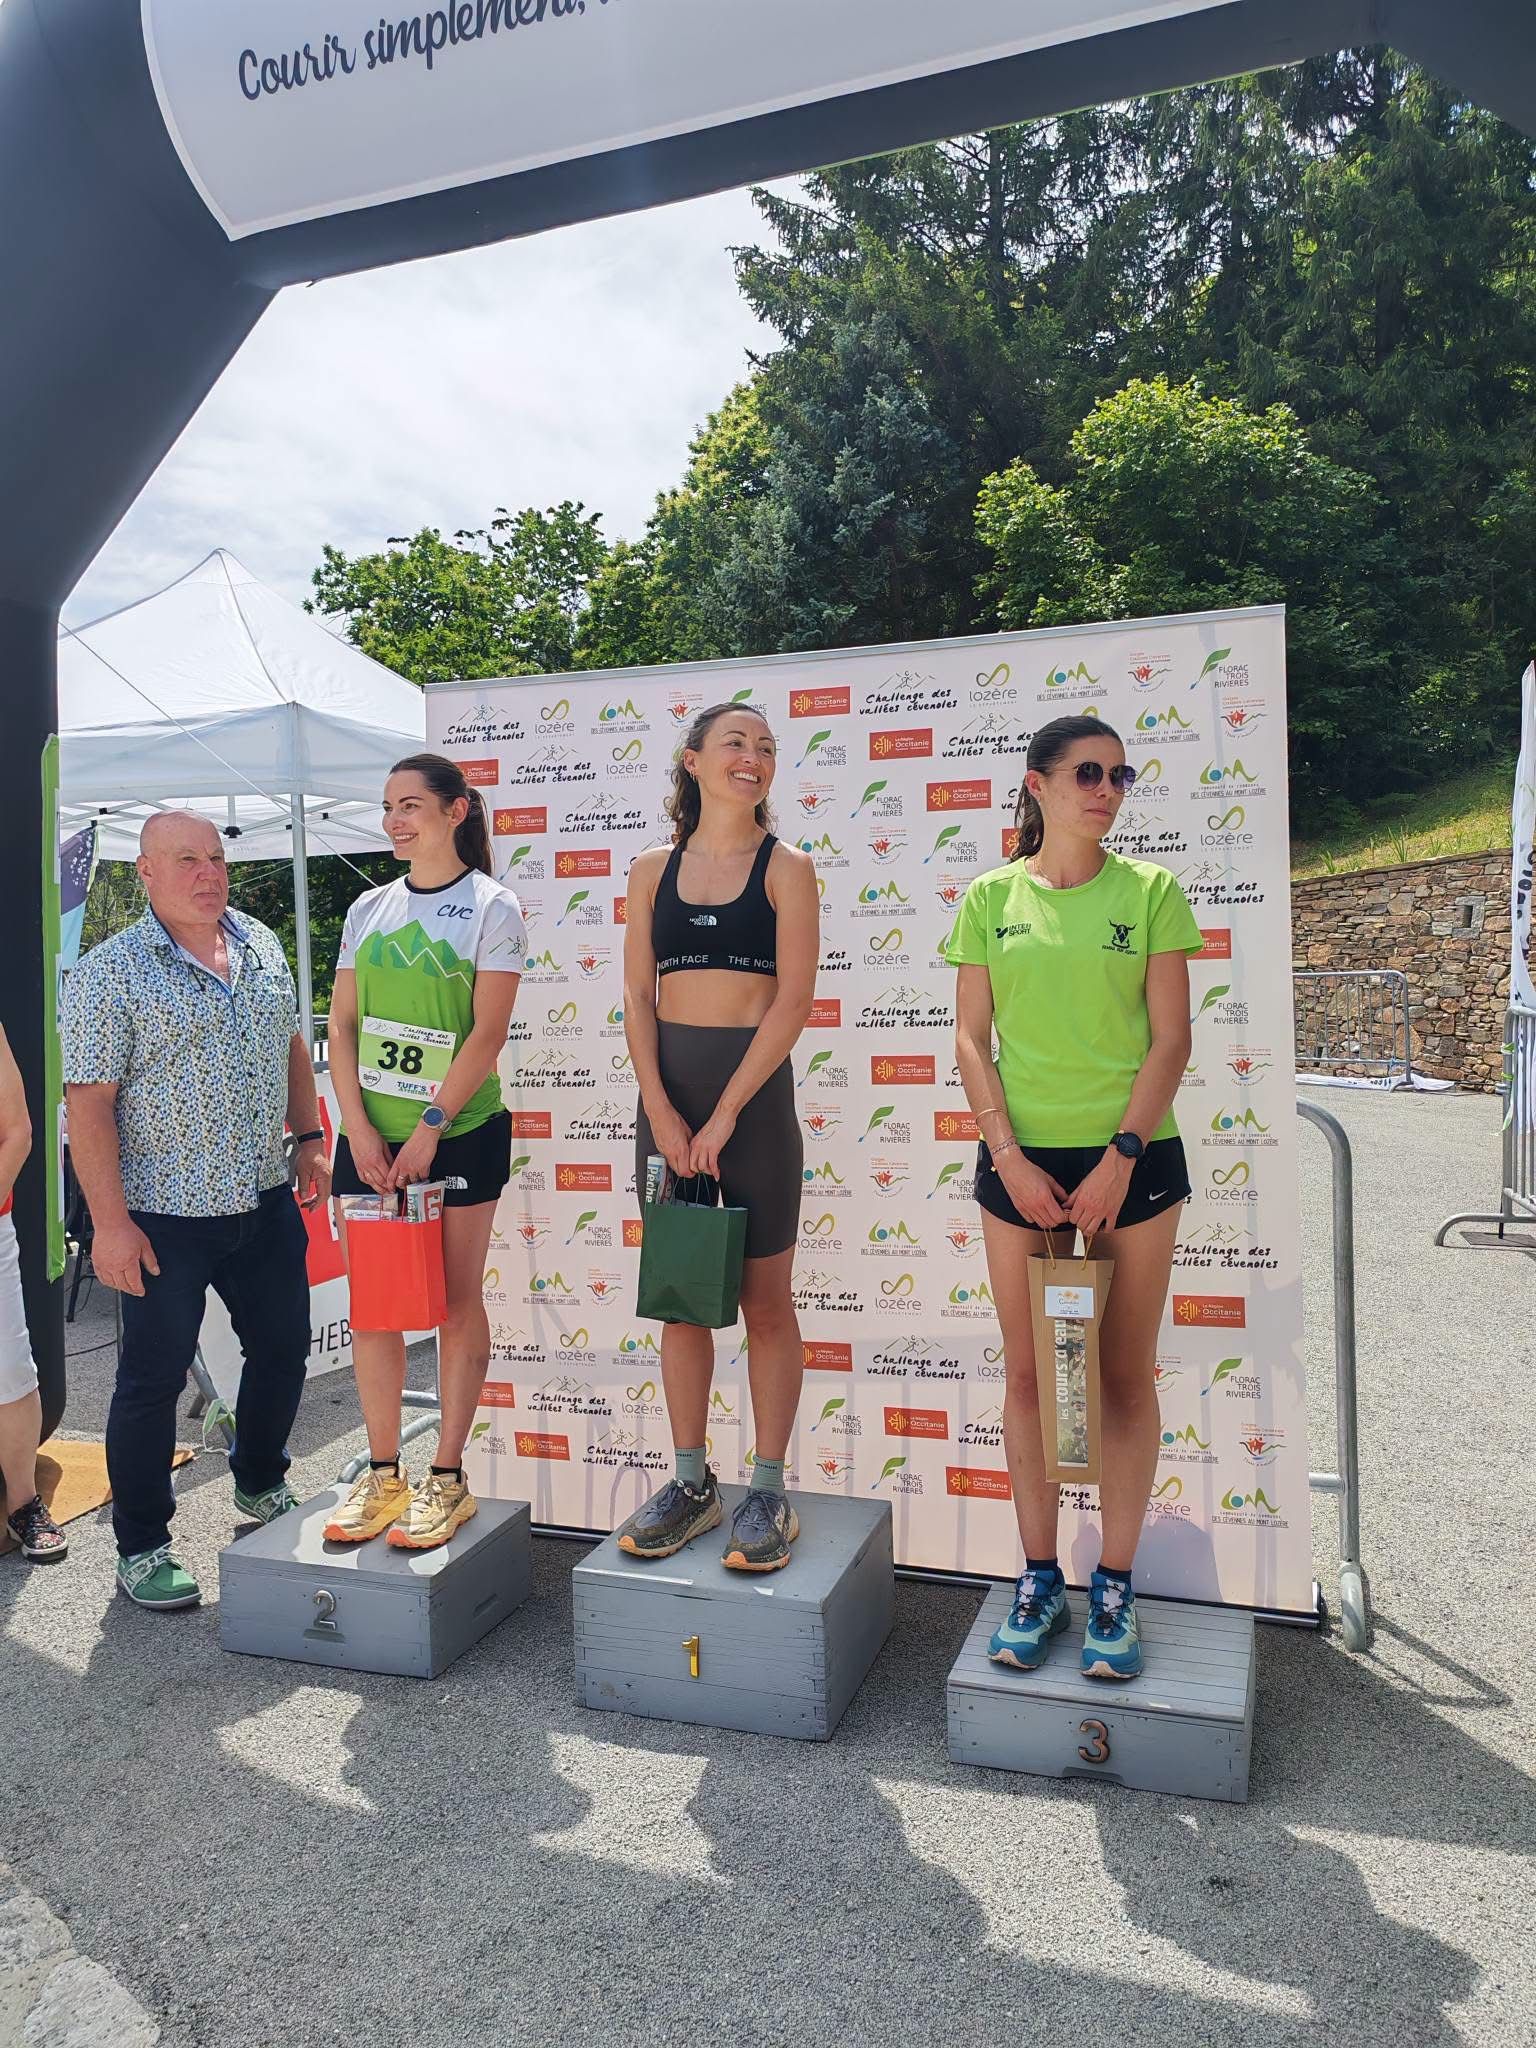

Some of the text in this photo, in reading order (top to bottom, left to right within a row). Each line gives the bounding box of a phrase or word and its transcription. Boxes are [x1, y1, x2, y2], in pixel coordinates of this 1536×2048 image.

[238, 33, 356, 100] Courir
[1218, 664, 1249, 674] FLORAC
[1226, 672, 1249, 680] TROIS
[866, 689, 952, 705] Challenge des
[969, 687, 1017, 702] lozère
[814, 698, 847, 706] Occitanie
[859, 700, 957, 716] vallées cévenoles
[447, 722, 520, 737] Challenge des
[535, 721, 575, 734] lozère
[442, 731, 525, 745] vallées cévenoles
[949, 733, 1010, 748] Challenge
[820, 745, 847, 753] FLORAC
[895, 740, 930, 748] Occitanie
[826, 752, 847, 760] TROIS
[942, 748, 983, 758] vallées
[516, 762, 591, 776] Challenge des
[606, 762, 648, 775] lozère
[511, 771, 597, 785] vallées cévenoles
[876, 796, 903, 804] FLORAC
[953, 791, 988, 800] Occitanie
[565, 811, 641, 825] Challenge des
[559, 820, 646, 833] vallées cévenoles
[1159, 831, 1180, 841] des
[1201, 832, 1254, 847] lozère
[950, 842, 978, 850] FLORAC
[1131, 843, 1188, 855] cévenoles
[956, 848, 978, 856] TROIS
[1235, 882, 1257, 892] des
[1207, 893, 1265, 906] cévenoles
[437, 904, 474, 920] CVC
[579, 905, 604, 913] FLORAC
[1009, 923, 1031, 931] INTER
[1008, 929, 1031, 937] SPORT
[681, 955, 709, 965] FACE
[826, 951, 846, 960] des
[863, 952, 910, 965] lozère
[728, 956, 775, 969] THE NOR
[1218, 1002, 1248, 1011] FLORAC
[862, 1007, 948, 1019] Challenge des
[1226, 1010, 1249, 1018] TROIS
[510, 1021, 527, 1030] des
[855, 1016, 954, 1028] vallées cévenoles
[542, 1025, 583, 1037] lozère
[377, 1040, 424, 1075] 38
[515, 1068, 590, 1079] Challenge des
[897, 1066, 932, 1074] Occitanie
[510, 1077, 596, 1088] vallées cévenoles
[828, 1073, 848, 1081] TROIS
[397, 1081, 427, 1092] TUFF'S
[570, 1120, 623, 1132] Challenge
[883, 1122, 911, 1130] FLORAC
[564, 1131, 600, 1141] vallées
[521, 1171, 545, 1179] FLORAC
[578, 1174, 609, 1182] Occitanie
[1205, 1187, 1259, 1201] lozère
[587, 1226, 612, 1234] FLORAC
[1174, 1244, 1271, 1258] Challenge des
[1172, 1257, 1278, 1269] allées cévenoles
[838, 1291, 858, 1301] des
[815, 1301, 864, 1312] cévenoles
[876, 1298, 922, 1311] lozère
[1202, 1308, 1241, 1316] Occitanie
[522, 1344, 540, 1352] des
[503, 1353, 546, 1363] cévenoles
[555, 1349, 596, 1362] lozère
[815, 1353, 849, 1362] Occitanie
[873, 1354, 959, 1368] Challenge des
[867, 1367, 966, 1380] vallées cévenoles
[1056, 1363, 1069, 1404] cours
[1230, 1376, 1261, 1384] FLORAC
[1238, 1383, 1261, 1391] TROIS
[532, 1393, 606, 1406] Challenge des
[527, 1404, 613, 1416] vallées cévenoles
[621, 1402, 663, 1416] lozère
[910, 1420, 945, 1429] Occitanie
[958, 1436, 1000, 1447] vallées
[587, 1446, 662, 1459] Challenge des
[582, 1456, 669, 1471] vallées cévenoles
[896, 1473, 922, 1481] FLORAC
[903, 1480, 923, 1488] TROIS
[973, 1480, 1008, 1489] Occitanie
[313, 1589, 337, 1631] 2
[681, 1634, 700, 1679] 1
[1078, 1718, 1111, 1764] 3
